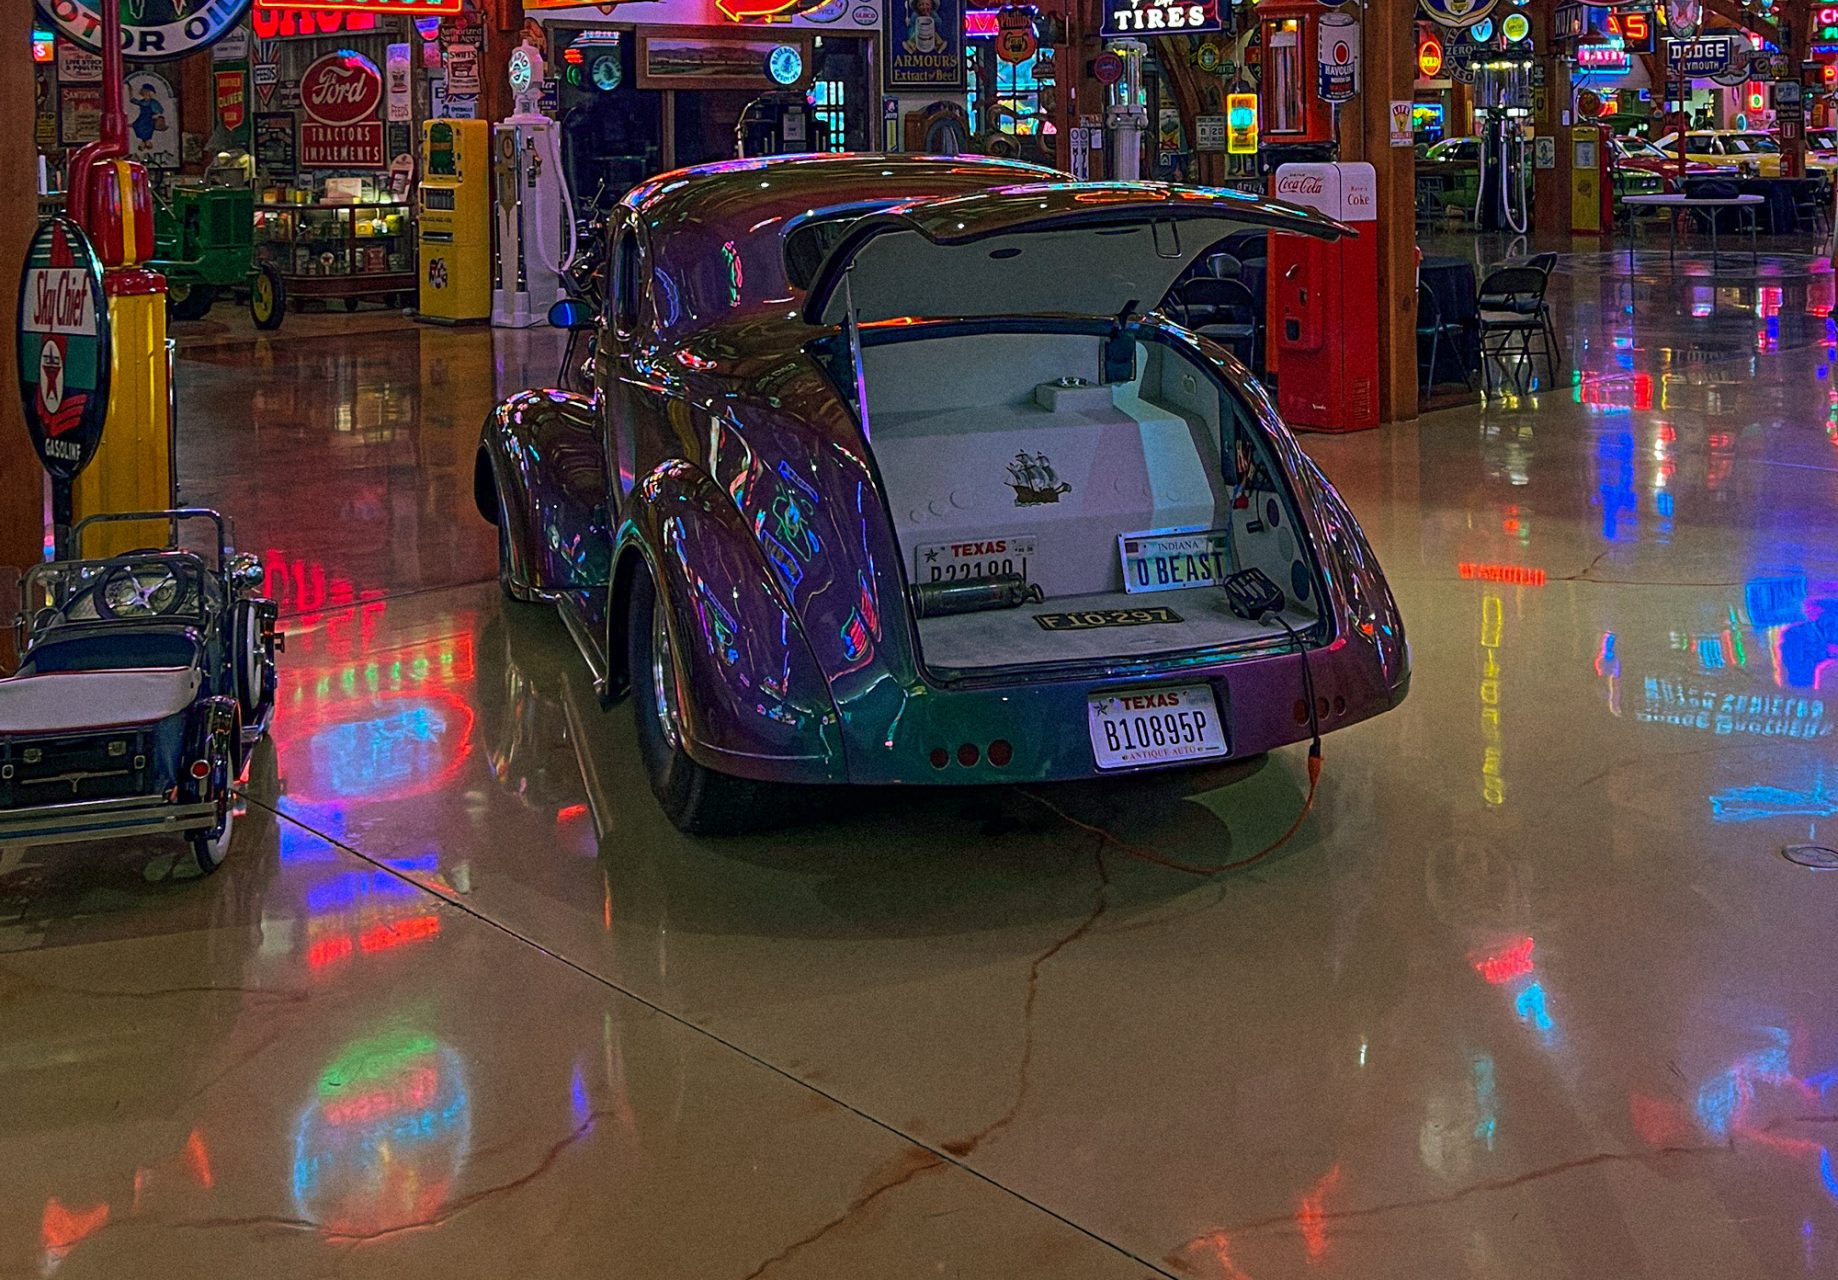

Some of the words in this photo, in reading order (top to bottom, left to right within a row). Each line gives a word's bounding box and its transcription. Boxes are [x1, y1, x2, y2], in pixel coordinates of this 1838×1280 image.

[1113, 4, 1206, 31] TIRES
[1671, 43, 1727, 59] DODGE
[311, 65, 369, 105] Ford
[894, 69, 928, 82] Extract
[936, 70, 957, 82] Beef
[311, 126, 371, 142] TRACTORS
[305, 145, 380, 162] IMPLEMENTS
[1347, 193, 1370, 206] Coke
[33, 270, 55, 331] Sky
[56, 269, 88, 328] Chief
[45, 437, 82, 461] GASOLINE
[950, 539, 1007, 558] TEXAS
[1157, 539, 1200, 553] INDIANA
[1157, 551, 1224, 585] BEAST
[1120, 692, 1180, 711] TEXAS
[1103, 710, 1208, 753] B10895P
[1129, 748, 1170, 761] ANTIQUE
[1171, 746, 1197, 757] AUTO
